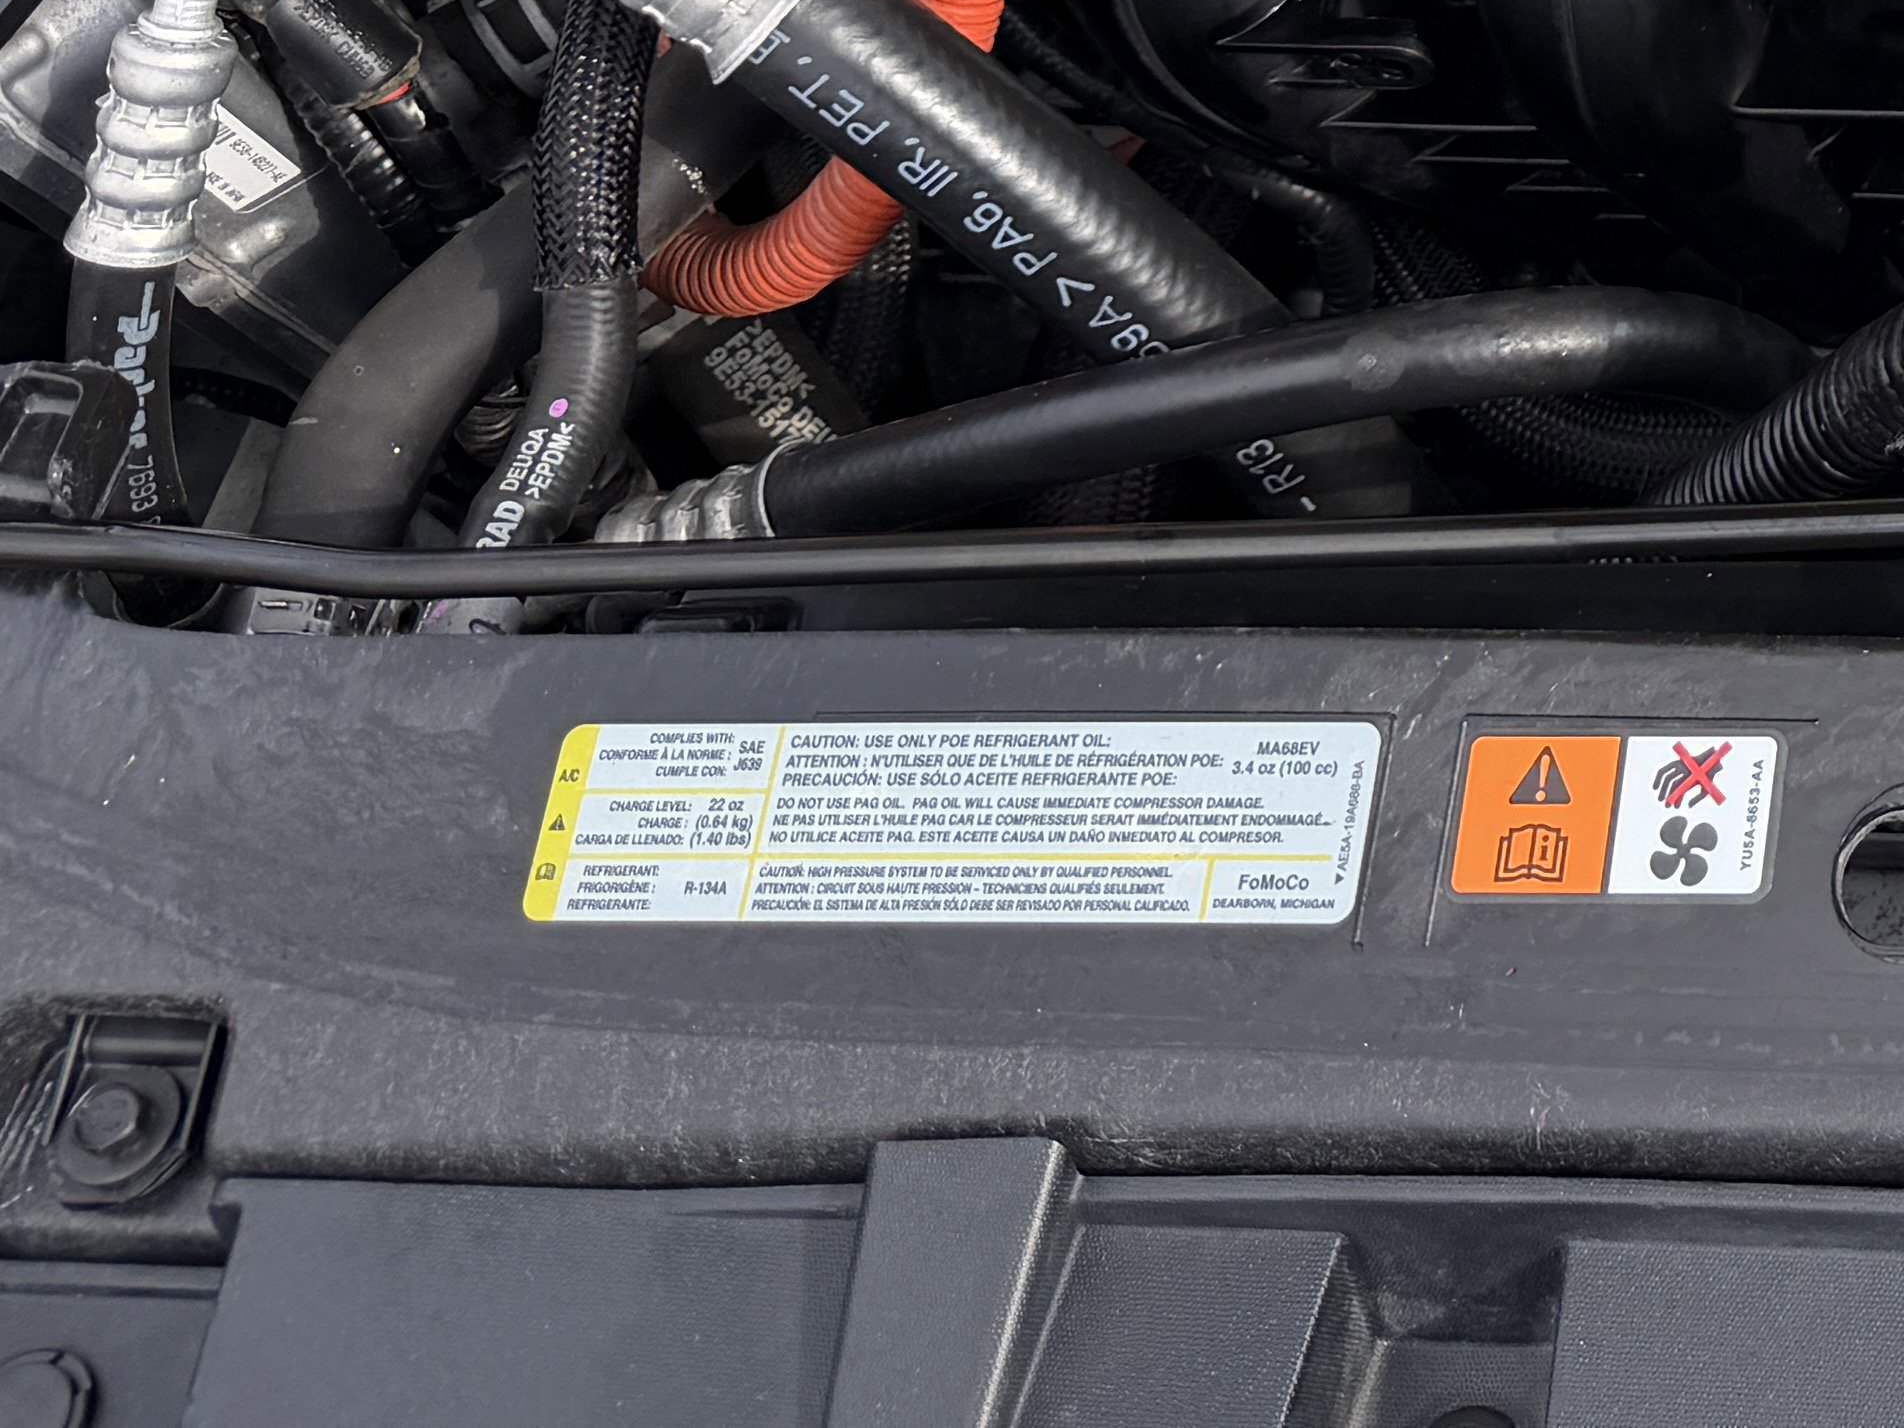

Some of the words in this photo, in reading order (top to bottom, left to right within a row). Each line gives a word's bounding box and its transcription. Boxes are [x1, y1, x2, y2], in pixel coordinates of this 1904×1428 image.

[738, 741, 766, 754] SAE
[789, 734, 861, 748] CAUTION:
[862, 734, 894, 748] USE
[895, 735, 937, 748] ONLY
[938, 735, 971, 747] POE
[972, 734, 1081, 748] REFRIGERANT
[1081, 734, 1112, 748] OIL:
[1255, 741, 1321, 755] MA68EV
[732, 757, 763, 771] J639
[1231, 761, 1254, 774] 3.4
[1256, 764, 1276, 775] oz
[1277, 760, 1311, 776] (100
[1313, 761, 1339, 776] cc)
[558, 769, 581, 782] A/C
[707, 798, 726, 811] 22
[727, 802, 745, 811] oz
[693, 815, 729, 831] (0.64
[729, 815, 755, 831] kg)
[688, 831, 724, 848] (1.40
[724, 831, 752, 848] lbs)
[682, 880, 729, 895] R-134A
[1237, 874, 1311, 890] FoMoCo
